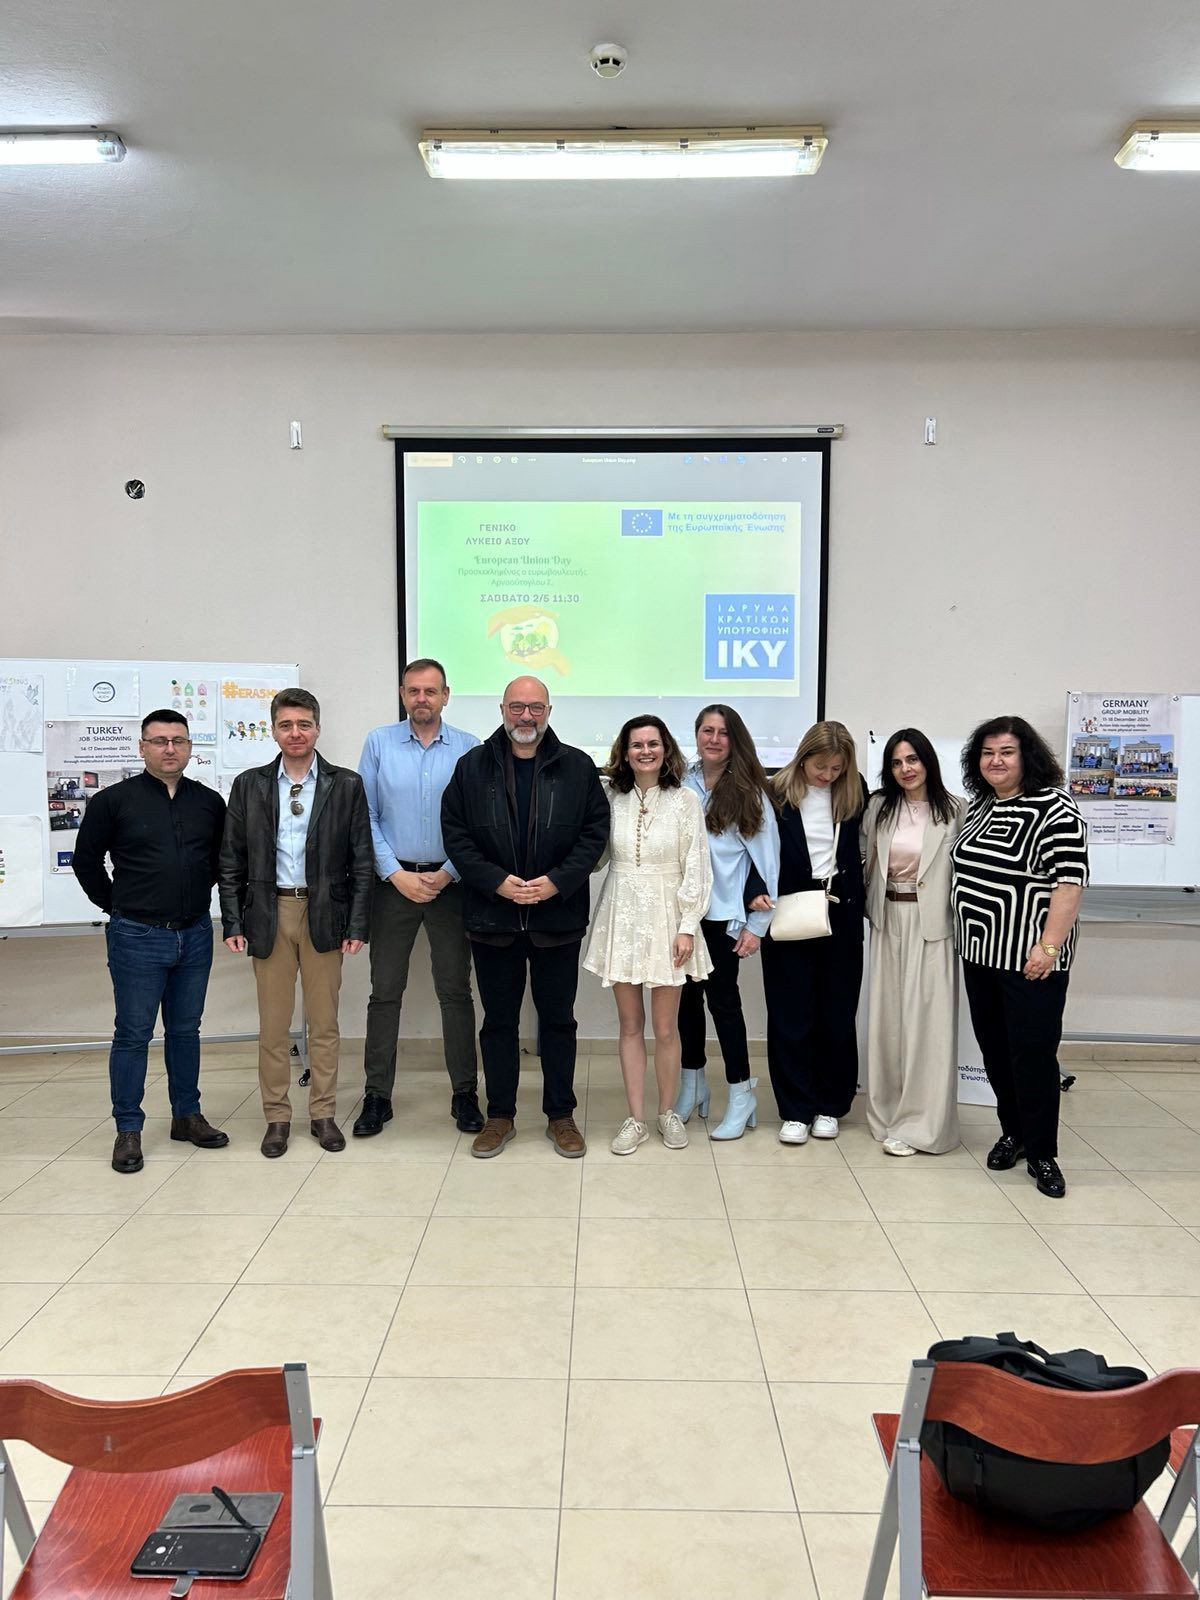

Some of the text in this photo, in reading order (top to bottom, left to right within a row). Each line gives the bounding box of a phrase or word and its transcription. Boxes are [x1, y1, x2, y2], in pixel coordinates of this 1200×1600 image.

[668, 512, 680, 520] Με
[684, 513, 693, 522] τη
[480, 524, 516, 532] ΓΕΝΙΚΟ
[668, 524, 684, 533] της
[465, 537, 530, 545] ΛΥΚΕΙΟ ΑΞΟΥ
[474, 555, 572, 567] European Union Day
[480, 594, 580, 603] ΣΑΒΒΑΤΟ 2/5 11:30
[718, 603, 789, 612] ΙΔΡΥΜΑ
[718, 615, 789, 624] ΚΡΑΤΙΚΩΝ
[718, 626, 789, 635] ΥΠΟΤΡΟΦΙΩΝ
[1102, 699, 1149, 708] GERMANY
[86, 726, 124, 735] TURKEY
